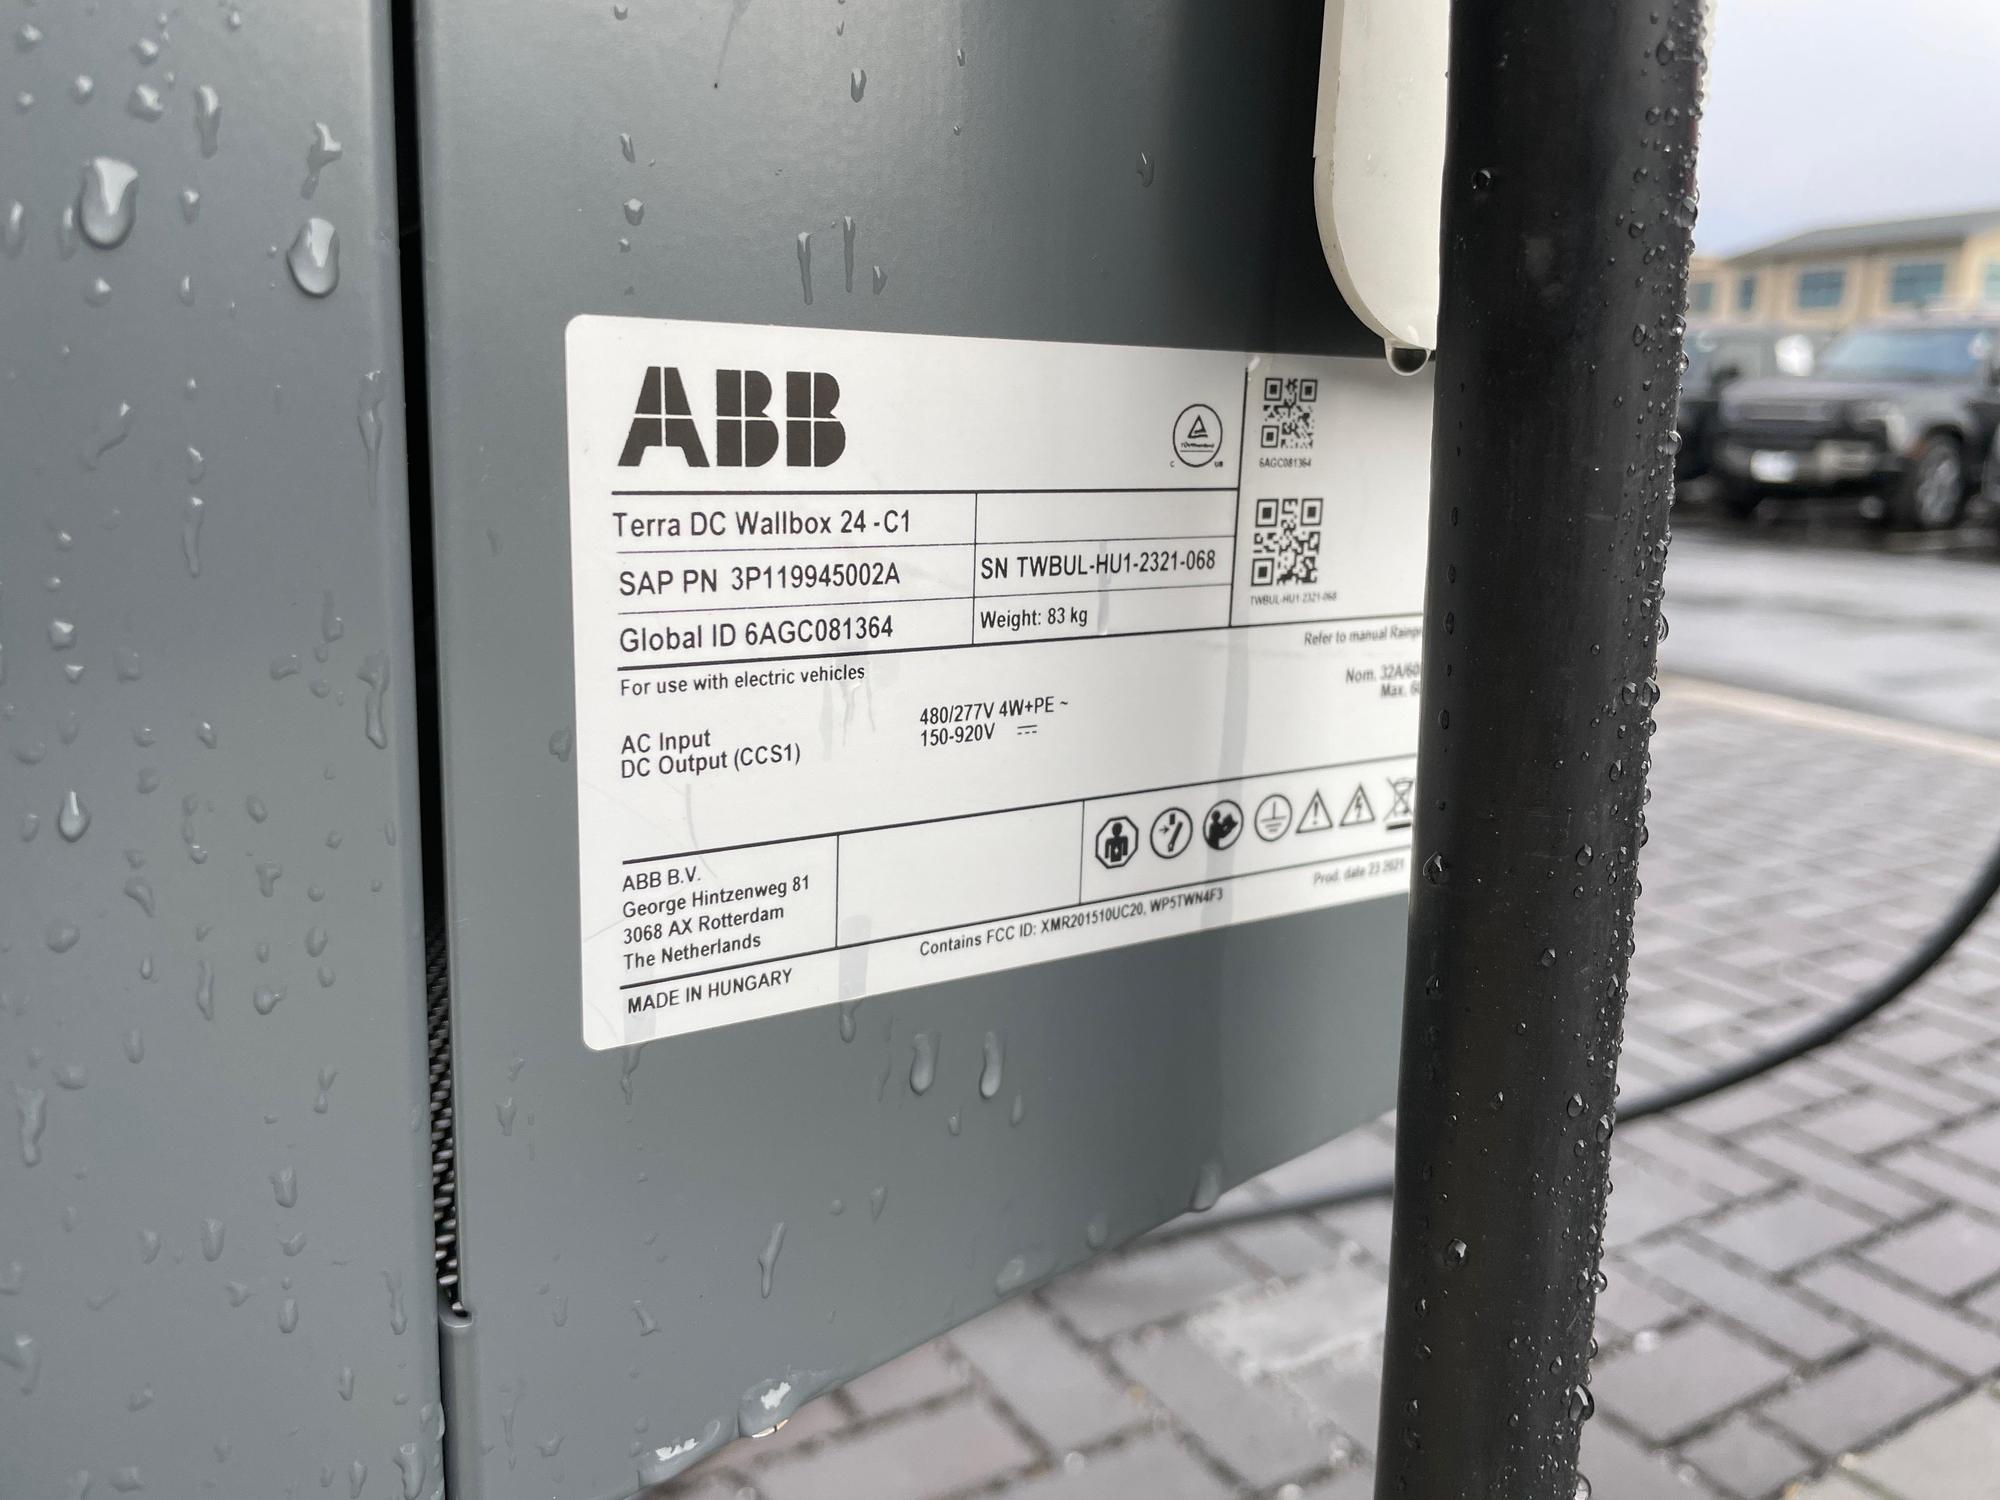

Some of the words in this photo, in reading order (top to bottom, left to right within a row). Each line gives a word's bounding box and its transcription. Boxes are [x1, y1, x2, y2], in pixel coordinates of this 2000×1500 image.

[617, 366, 846, 467] ABB
[612, 512, 680, 537] Terra
[690, 511, 726, 536] DC
[736, 509, 832, 535] Wallbox
[841, 510, 866, 533] 24
[619, 570, 673, 596] SAP
[683, 568, 718, 594] PN
[731, 562, 900, 590] 3P119945002A
[980, 557, 1008, 580] SN
[1017, 550, 1216, 578] TWBUL-HU1-2321-068
[619, 624, 702, 653] Global
[712, 624, 736, 647] ID
[744, 614, 894, 646] 6AGC081364
[980, 610, 1042, 632] Weight:
[1048, 608, 1065, 624] 83
[1070, 606, 1088, 627] kg
[1304, 630, 1332, 646] Refer
[1336, 630, 1346, 644] to
[1349, 627, 1388, 642] manual
[620, 678, 651, 696] For
[656, 678, 688, 694] use
[693, 674, 729, 692] with
[734, 670, 796, 688] electric
[800, 664, 865, 684] vehicles
[1345, 668, 1377, 684] Nom.
[1380, 683, 1407, 698] Max.
[920, 702, 994, 725] 480/277V
[999, 696, 1054, 717] 4W+PE
[621, 734, 651, 755] AC
[658, 728, 711, 756] Input
[920, 722, 996, 747] 150-920V
[621, 758, 651, 779] DC
[658, 752, 728, 776] Output
[734, 743, 801, 772] (CCS1)
[622, 871, 662, 892] ABB
[668, 866, 702, 886] B.V.
[622, 895, 687, 918] George
[692, 880, 788, 910] Hintzenweg
[792, 875, 810, 892] 81
[624, 926, 663, 945] 3068
[668, 918, 692, 937] AX
[698, 906, 784, 932] Rotterdam
[920, 934, 982, 956] Contains
[986, 926, 1015, 944] FCC
[1020, 922, 1036, 937] ID:
[1041, 904, 1147, 934] XMR201510UC20,
[1150, 888, 1223, 913] WP5TWN4F3
[624, 950, 656, 970] The
[661, 932, 761, 964] Netherlands
[628, 990, 680, 1014] MADE
[686, 985, 702, 1003] IN
[708, 968, 793, 998] HUNGARY
